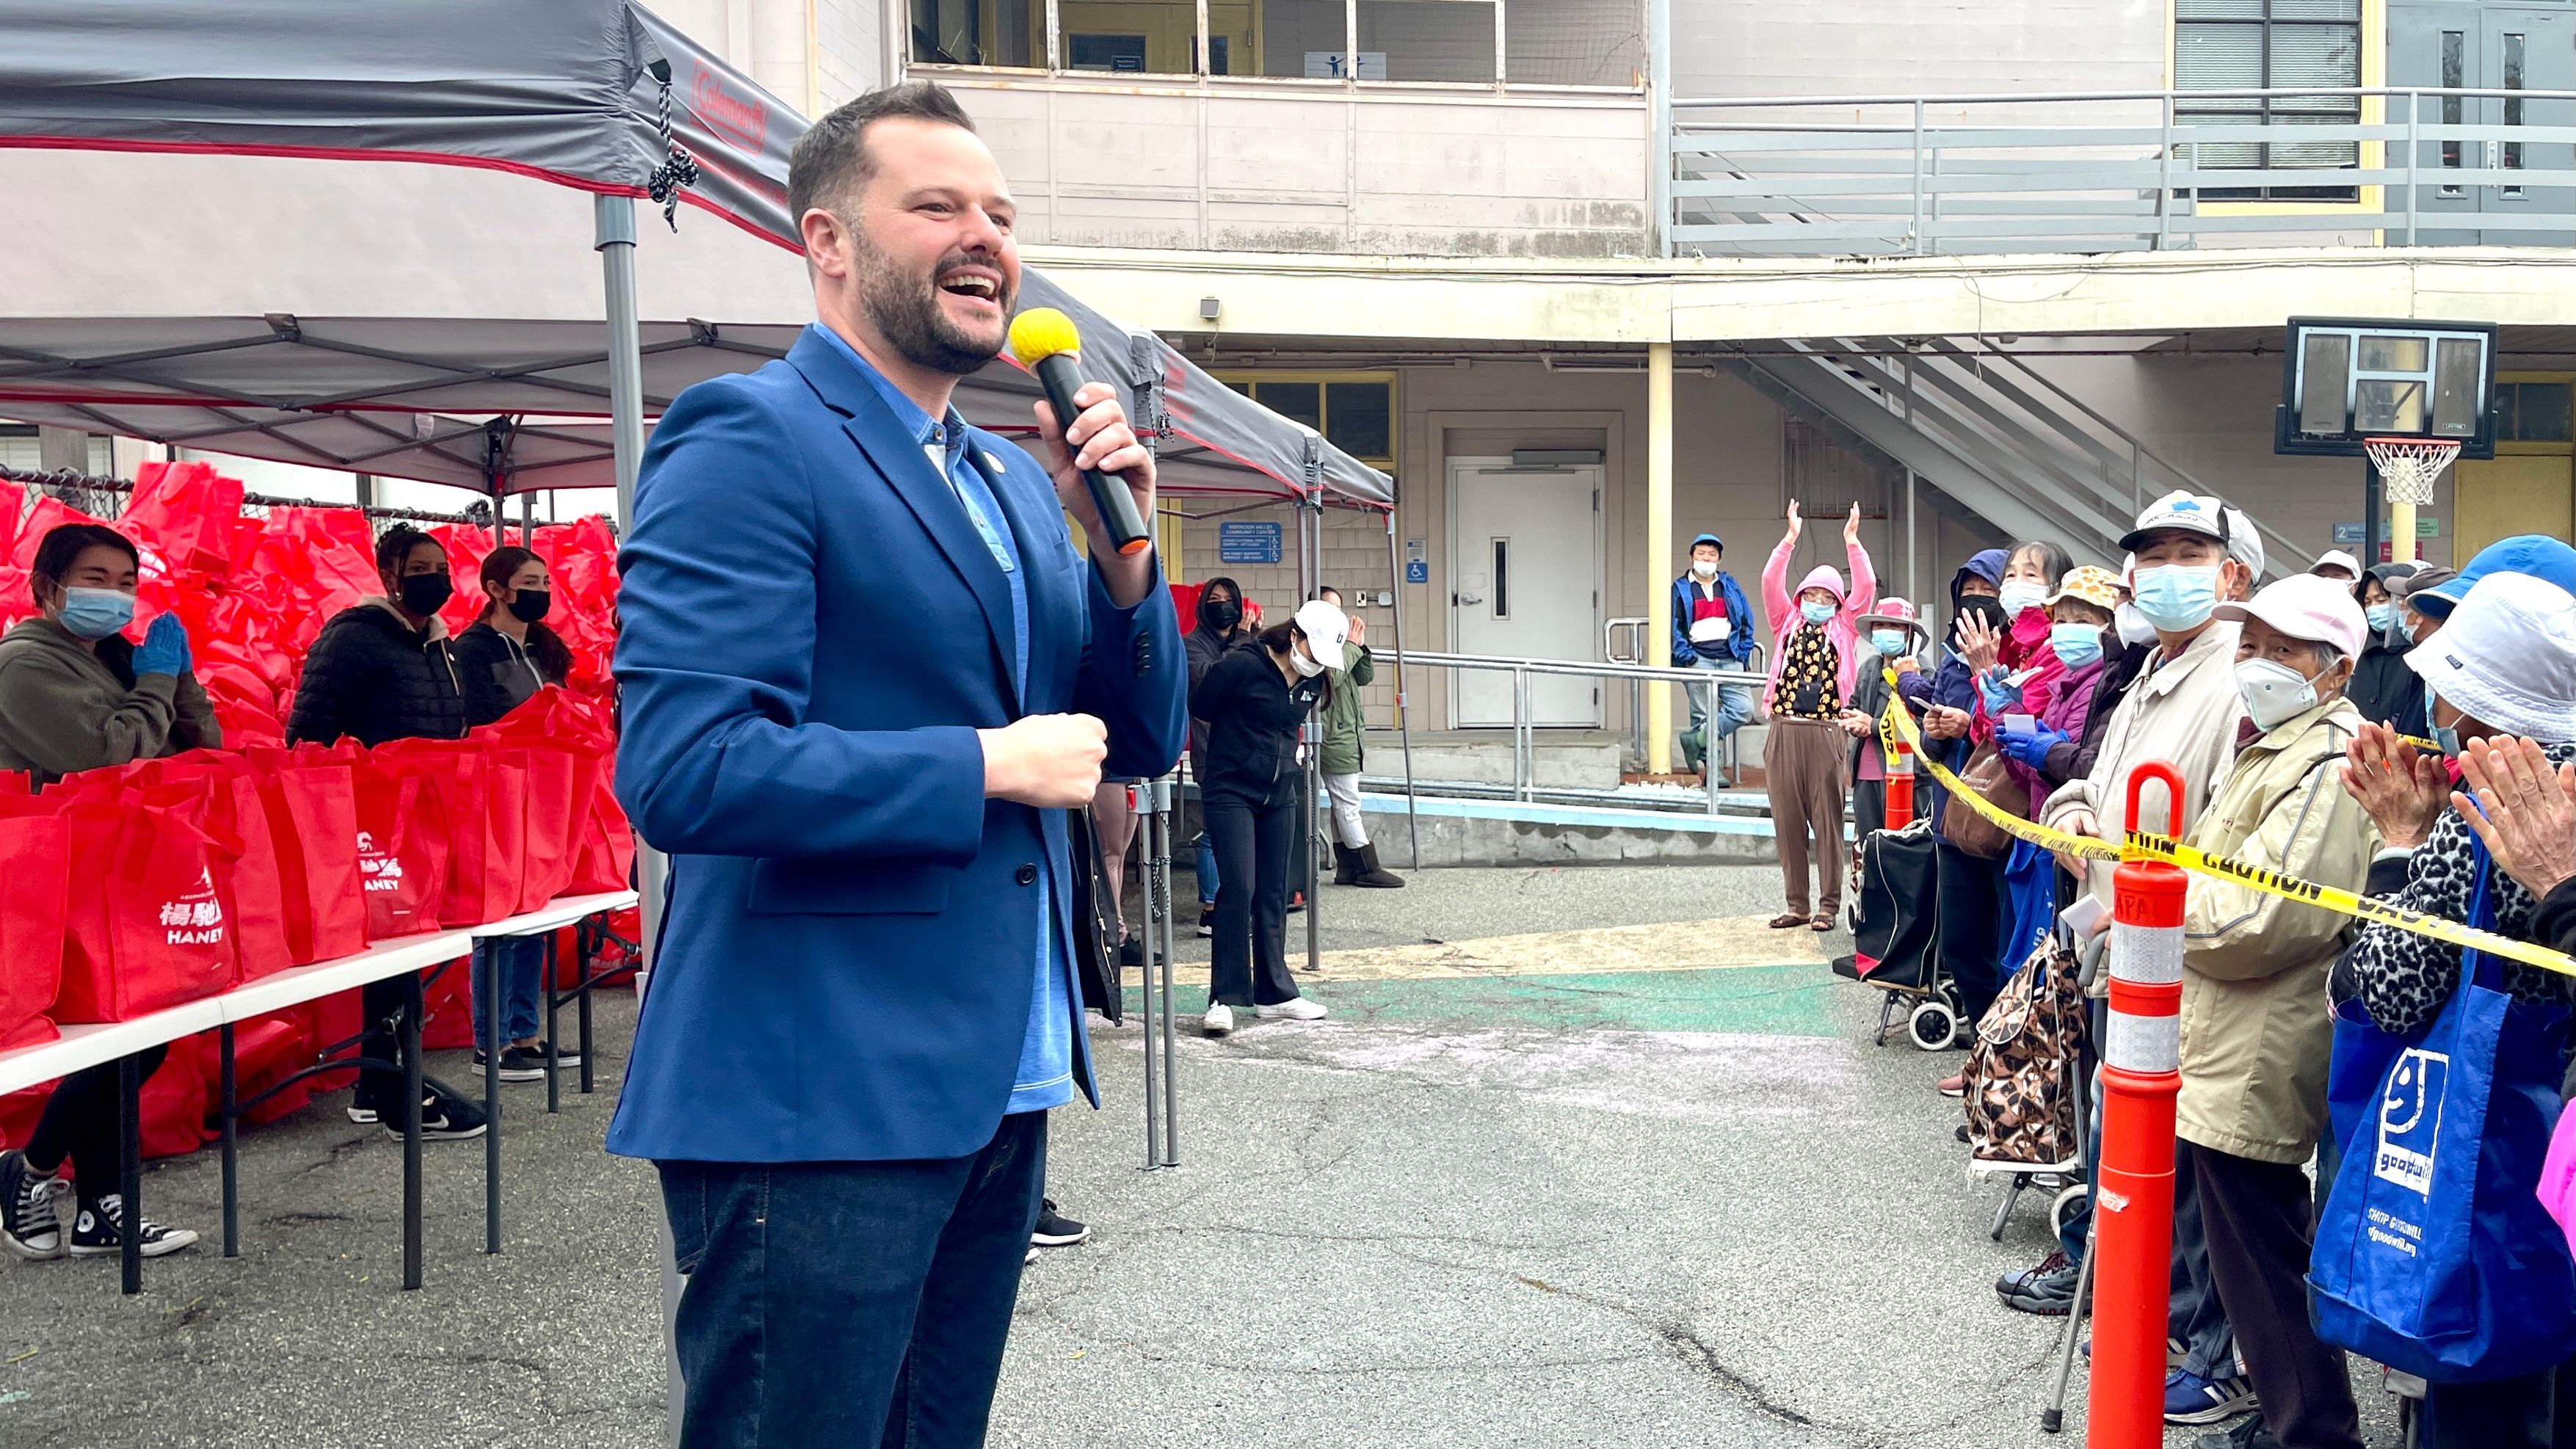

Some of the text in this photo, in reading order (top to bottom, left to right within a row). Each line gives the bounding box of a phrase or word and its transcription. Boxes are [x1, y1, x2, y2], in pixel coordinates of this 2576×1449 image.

[2337, 526, 2346, 539] 2
[2202, 851, 2323, 901] CAUTION
[167, 926, 223, 945] HANEY
